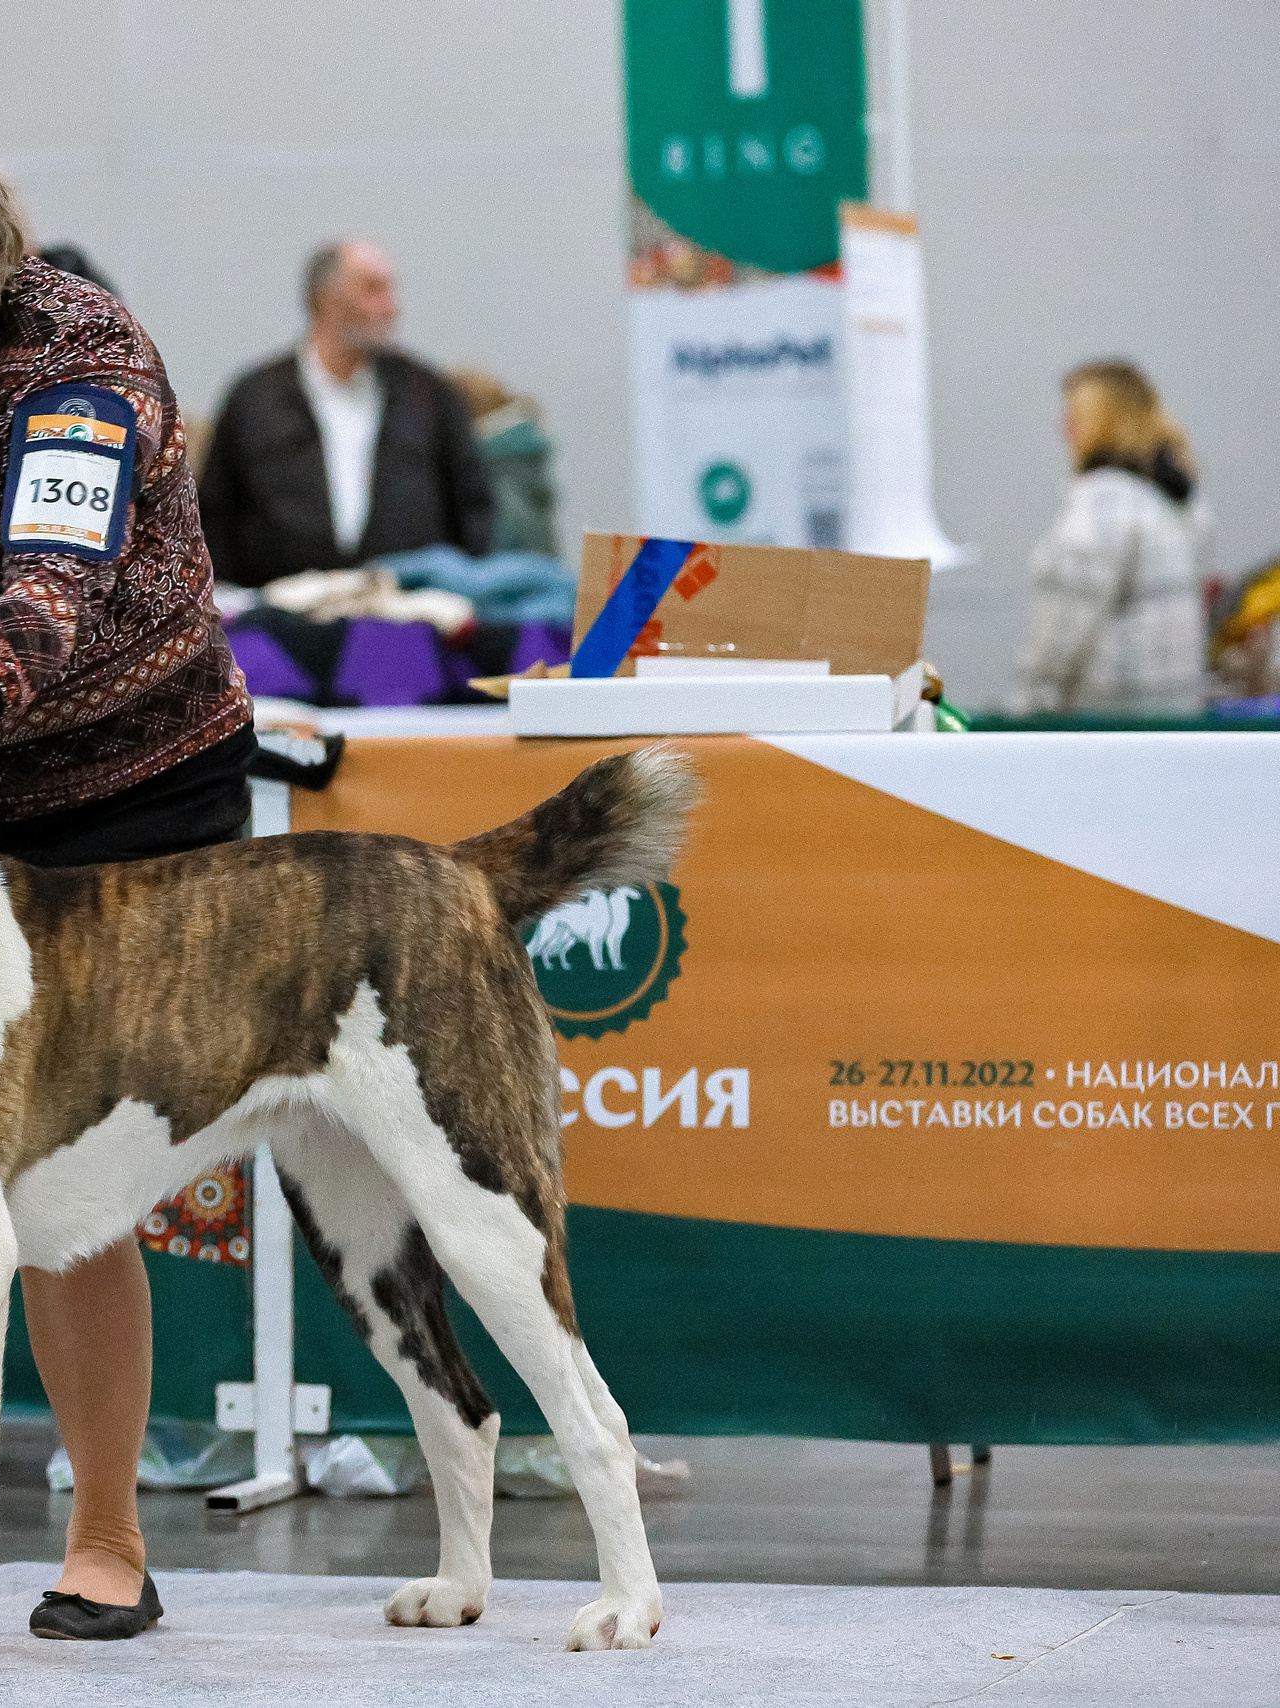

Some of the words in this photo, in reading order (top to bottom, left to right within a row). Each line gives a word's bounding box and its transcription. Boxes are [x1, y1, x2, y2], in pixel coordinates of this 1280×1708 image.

[30, 478, 109, 512] 1308
[829, 1059, 1035, 1088] 26-27.11.2022
[1067, 1060, 1279, 1093] НАЦИОНАЛ
[829, 1100, 1022, 1128] ВЫСТАВКИ
[1032, 1100, 1154, 1130] СОБАК
[1165, 1101, 1254, 1130] ВСЕХ
